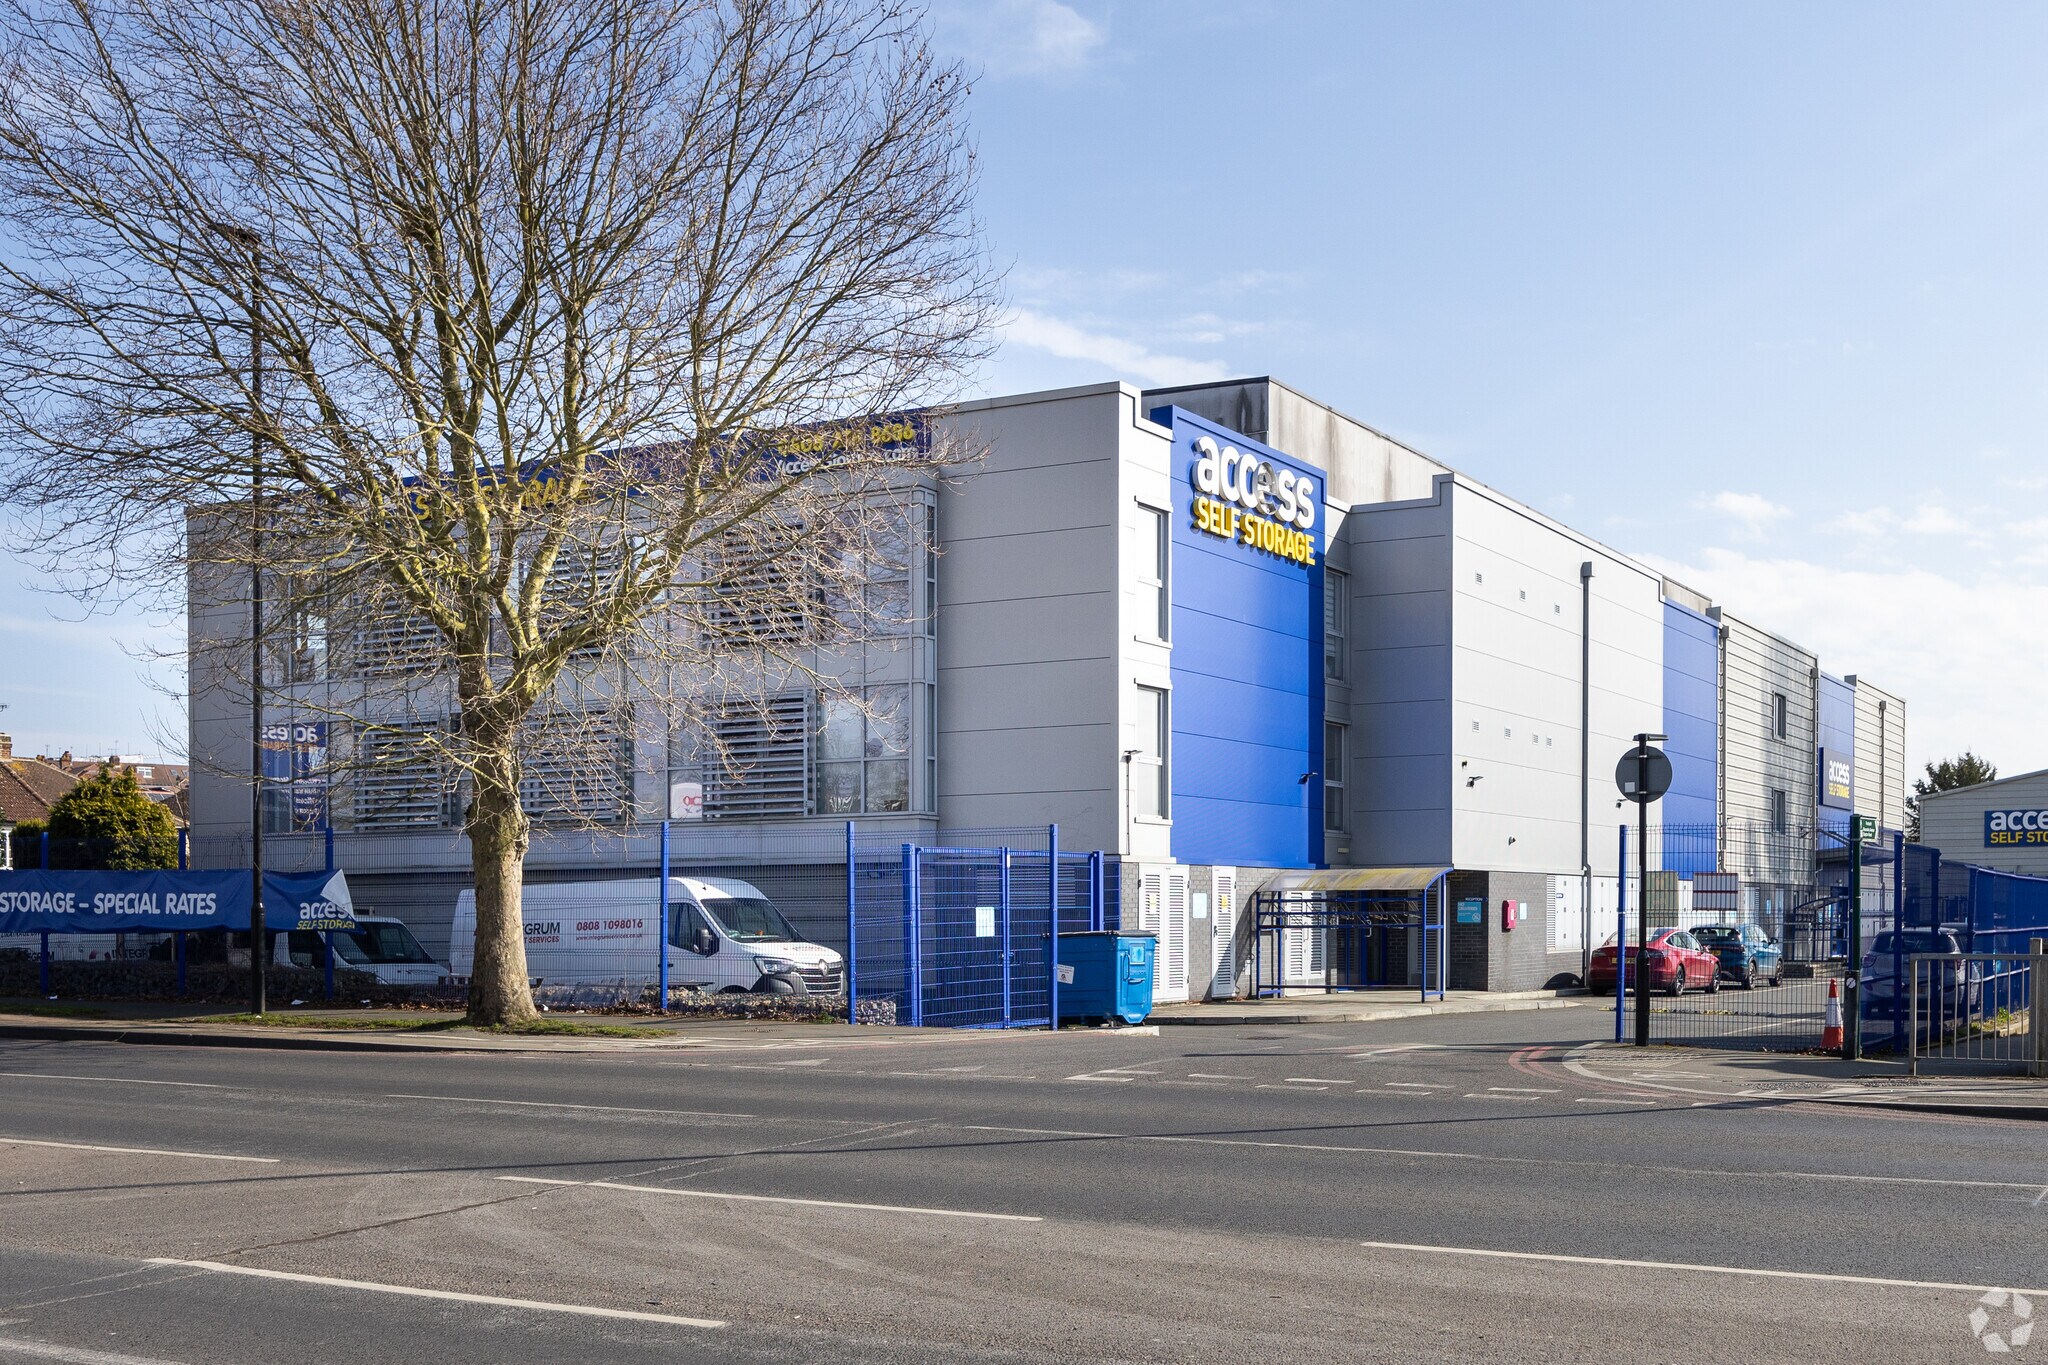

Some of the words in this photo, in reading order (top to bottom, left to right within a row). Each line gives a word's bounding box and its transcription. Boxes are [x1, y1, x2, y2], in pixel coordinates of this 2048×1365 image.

[1192, 435, 1315, 529] access
[1194, 496, 1242, 539] SELF
[1240, 513, 1316, 566] STORAGE
[1828, 760, 1850, 785] access
[1990, 831, 2024, 844] SELF
[0, 891, 76, 913] STORAGE
[93, 892, 161, 914] SPECIAL
[165, 893, 217, 915] RATES
[296, 920, 317, 930] SELF
[576, 921, 600, 931] 0808
[603, 919, 643, 930] 1098016
